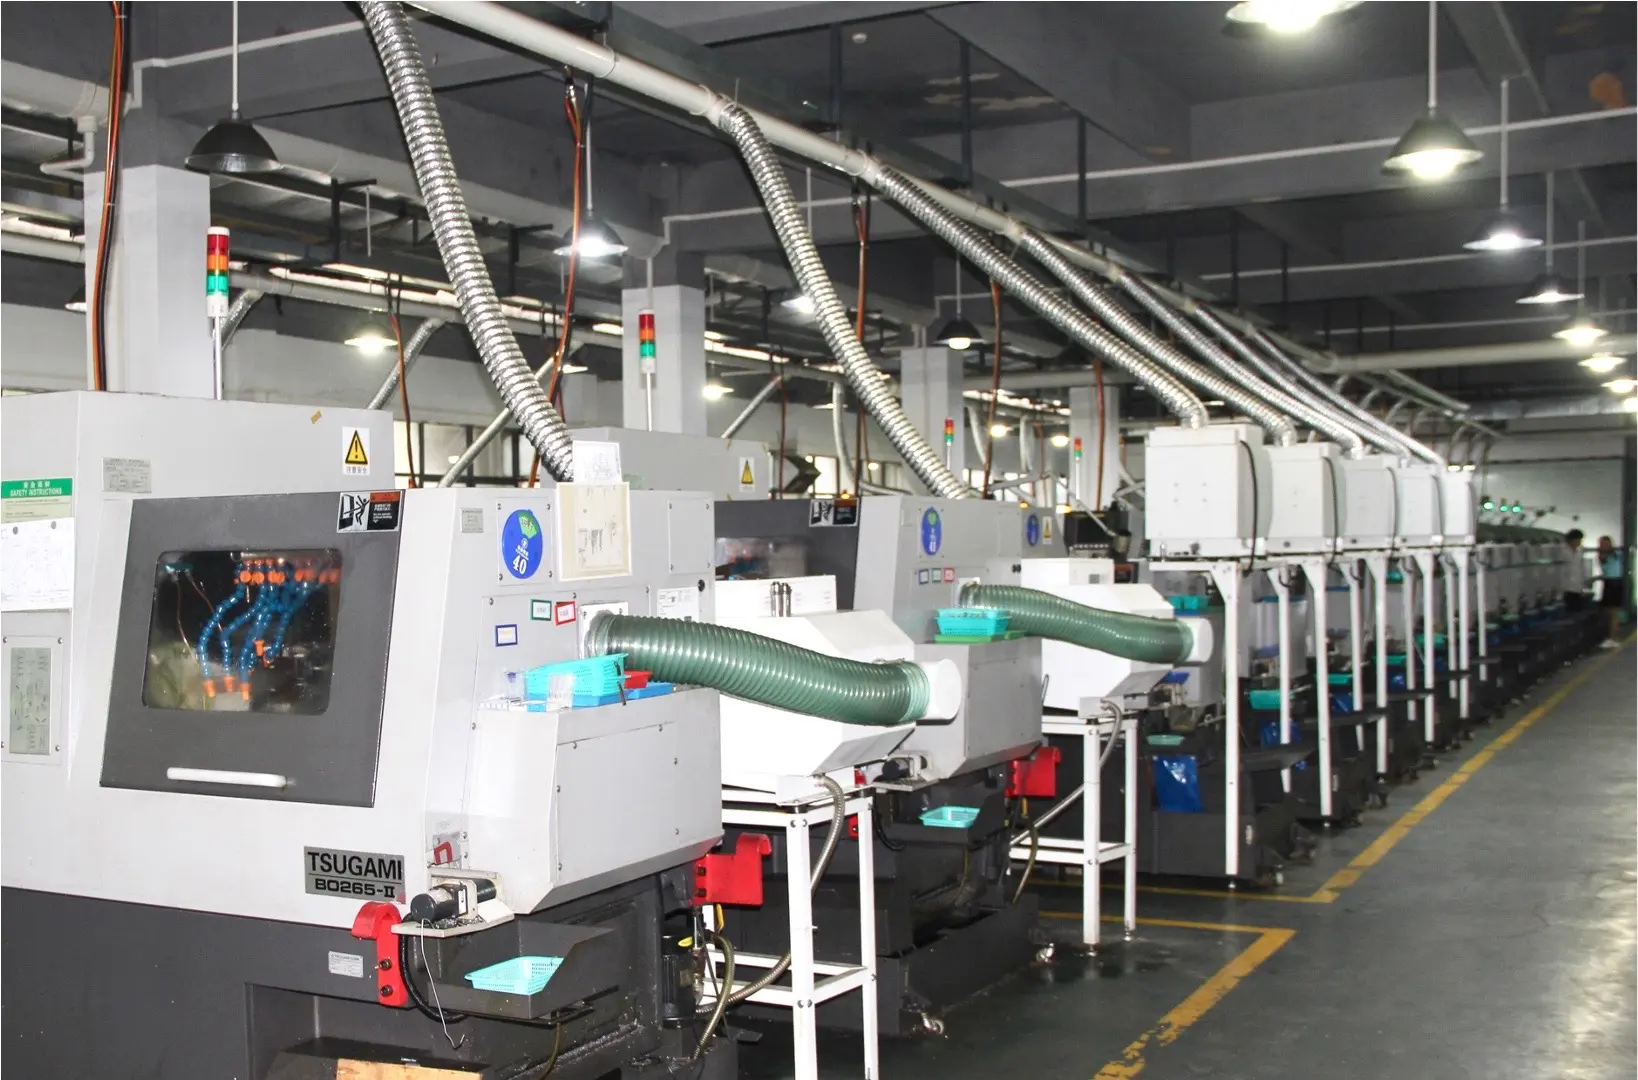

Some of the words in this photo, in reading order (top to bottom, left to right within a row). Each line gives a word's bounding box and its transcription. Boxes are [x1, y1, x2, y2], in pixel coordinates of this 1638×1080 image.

[10, 488, 28, 497] SAFETY
[29, 487, 62, 496] INSTRUCTIONS
[512, 554, 527, 575] 40
[307, 851, 402, 880] TSUGAMI
